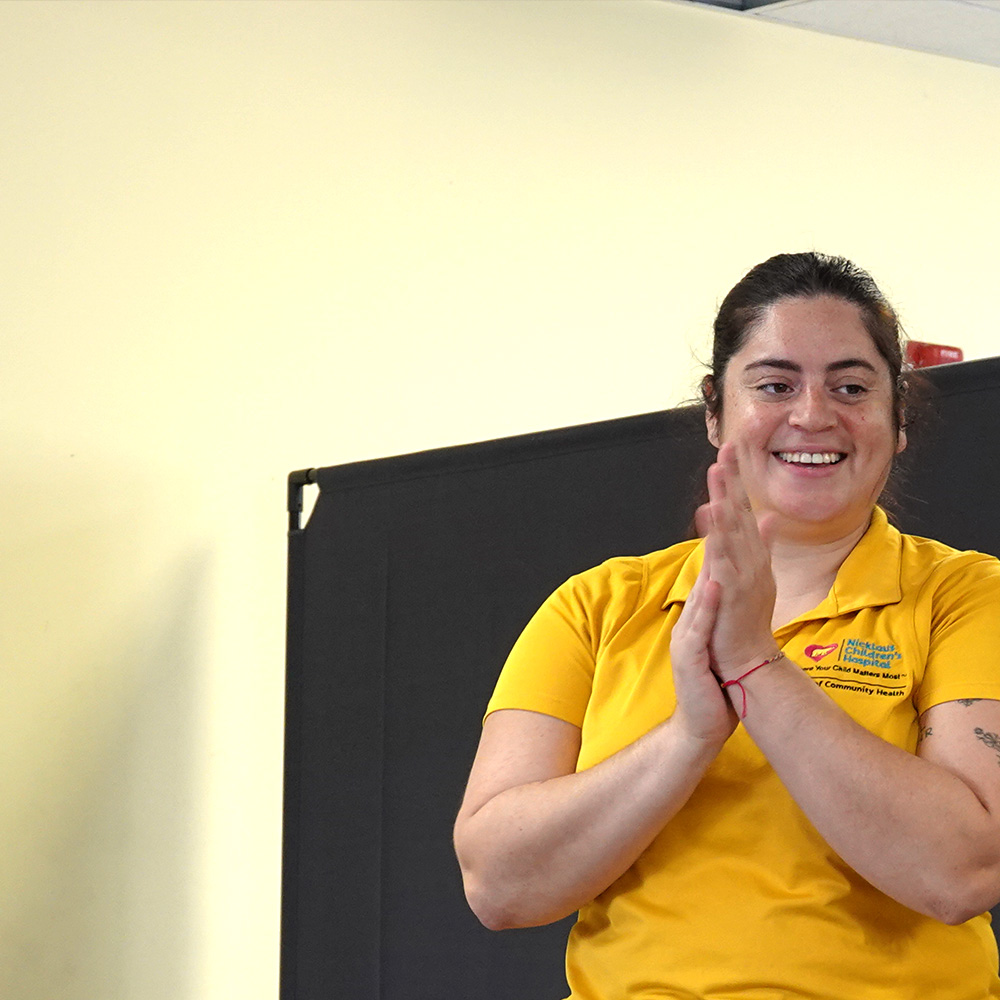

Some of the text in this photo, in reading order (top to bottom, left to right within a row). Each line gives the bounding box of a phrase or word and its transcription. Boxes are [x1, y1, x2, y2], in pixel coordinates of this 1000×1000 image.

[846, 639, 895, 652] Nicklaus
[844, 646, 902, 660] Children's
[843, 654, 891, 669] Hospital
[832, 665, 851, 673] Child
[852, 668, 880, 678] Matters
[824, 681, 874, 695] Community
